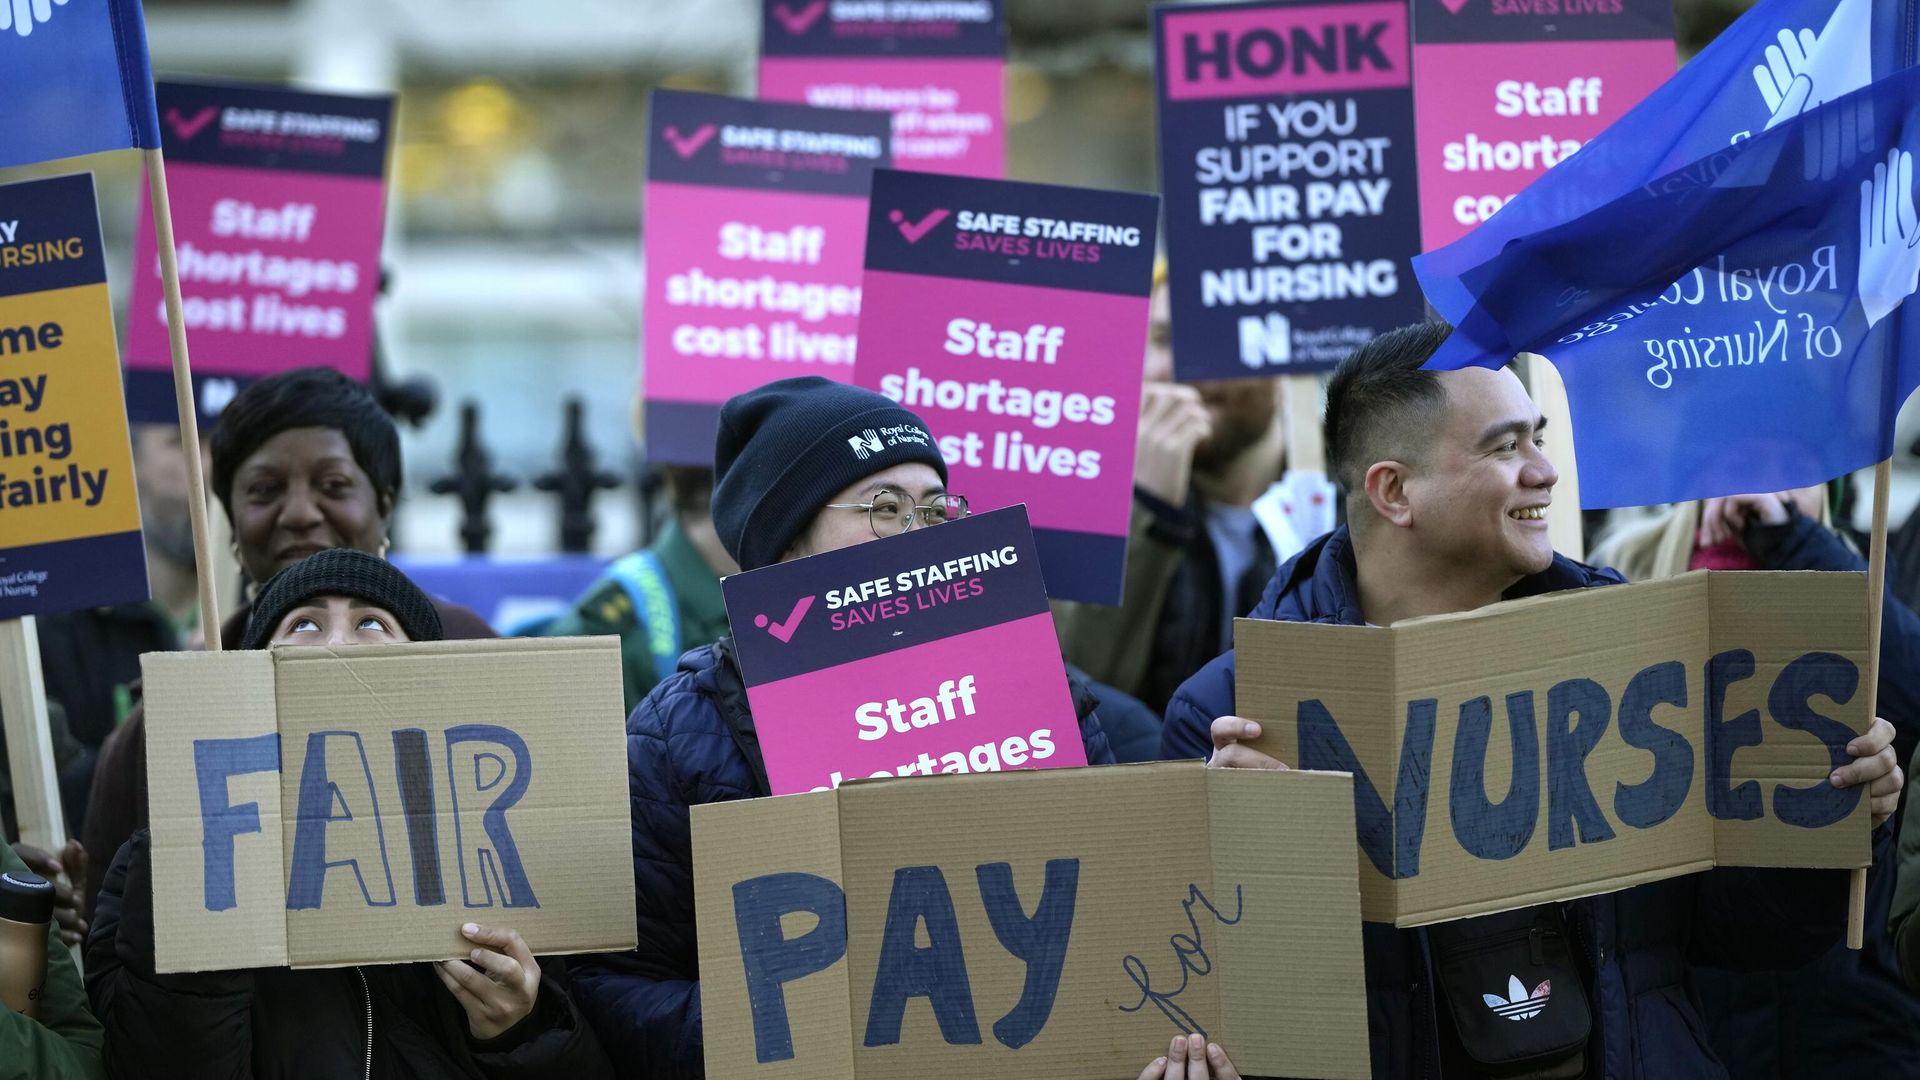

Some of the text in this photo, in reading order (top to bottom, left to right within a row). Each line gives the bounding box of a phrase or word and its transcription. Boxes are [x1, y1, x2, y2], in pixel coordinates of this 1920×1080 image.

[1182, 20, 1393, 82] HONK
[1494, 76, 1603, 117] Staff
[1223, 99, 1357, 142] IF YOU
[1195, 137, 1391, 184] SUPPORT
[1443, 133, 1594, 171] shorta
[211, 198, 316, 241] Staff
[1199, 178, 1391, 225] FAIR PAY
[0, 236, 84, 268] RSING
[717, 221, 825, 265] Staff
[954, 231, 1100, 263] SAVES LIVES
[957, 210, 1141, 248] SAFE STAFFING
[1252, 223, 1342, 262] FOR
[1200, 259, 1398, 307] NURSING
[252, 291, 347, 338] lives
[672, 323, 764, 360] cost
[944, 317, 1065, 364] Staff
[879, 367, 1116, 428] shortages
[992, 431, 1101, 479] lives
[825, 545, 1019, 609] SAFE STAFFING
[830, 576, 985, 632] SAVES LIVES
[854, 674, 977, 741] Staff
[1296, 647, 1862, 880] NURSES
[193, 723, 542, 913] FAIR
[732, 858, 1243, 1064] PAY for
